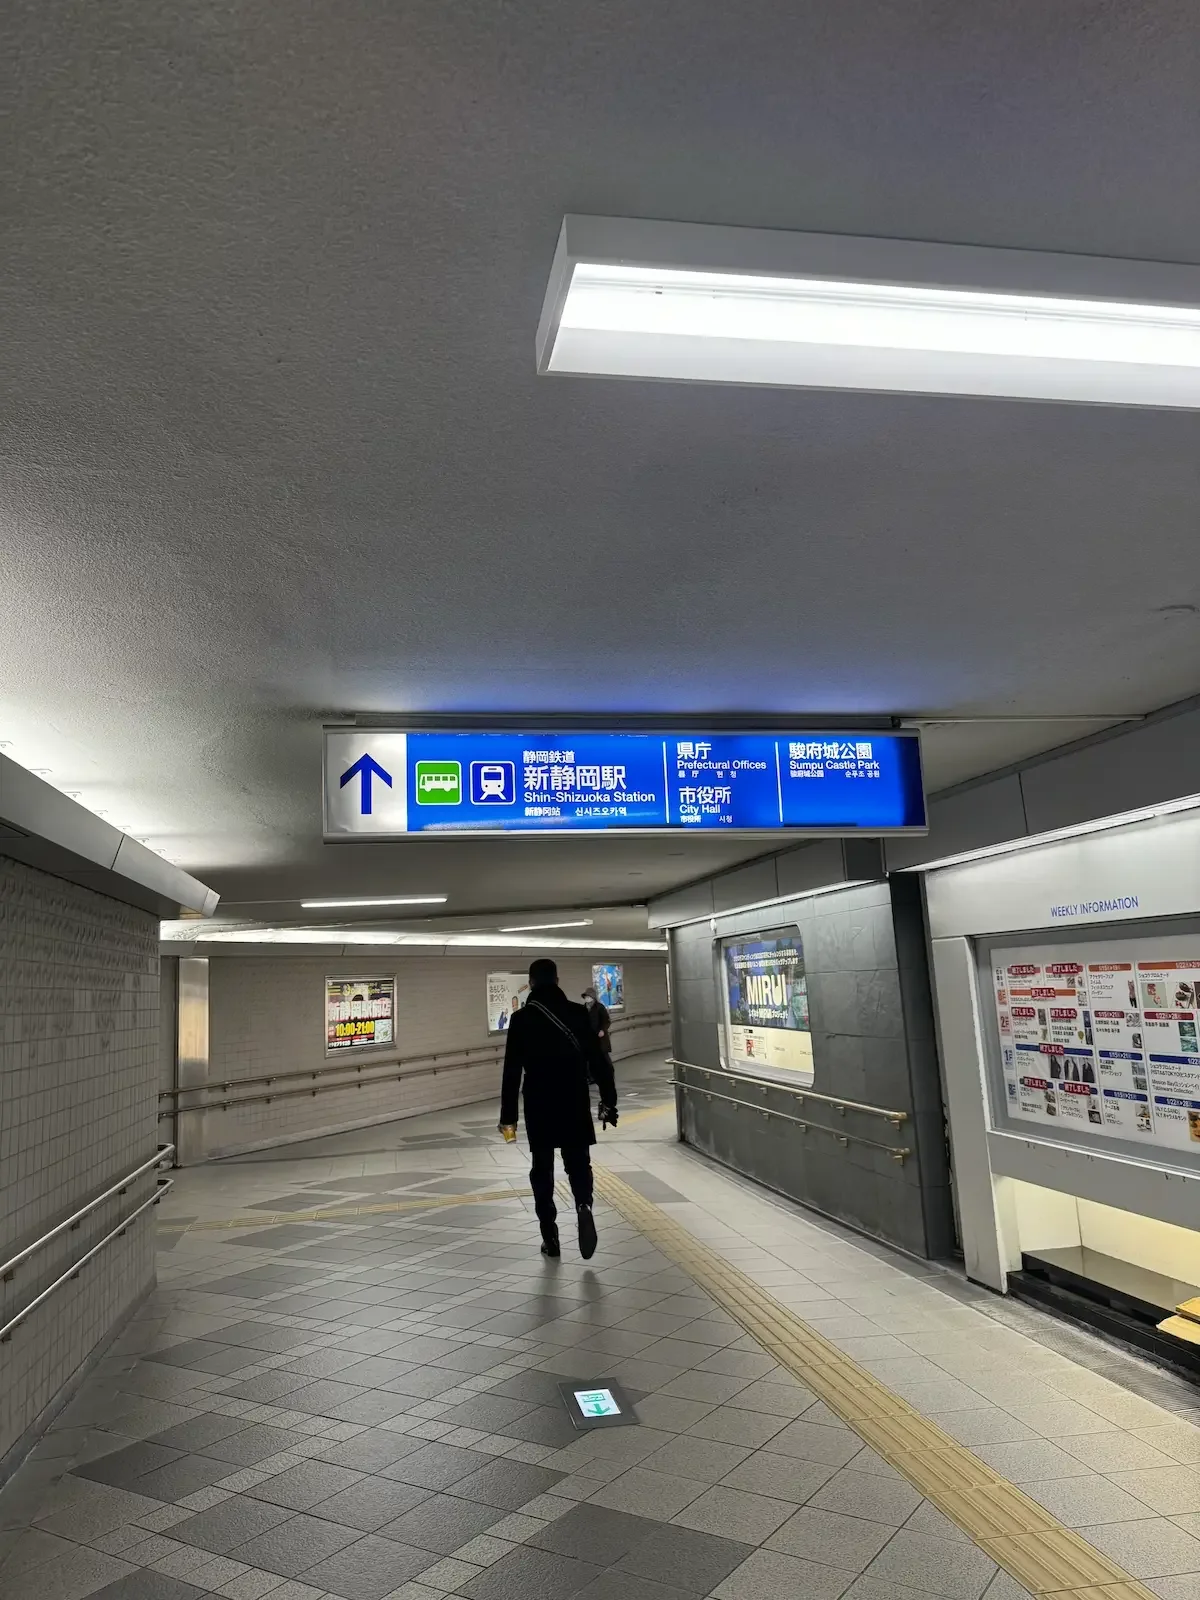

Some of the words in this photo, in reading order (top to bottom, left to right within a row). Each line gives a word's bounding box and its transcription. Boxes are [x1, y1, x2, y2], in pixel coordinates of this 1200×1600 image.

[523, 751, 575, 764] 静岡鉄道
[677, 742, 712, 760] 県庁
[789, 742, 873, 760] 駿府城公園
[677, 760, 730, 770] Prefectural
[732, 760, 767, 770] Offices
[790, 760, 823, 773] Sumpu
[826, 760, 855, 770] Castle
[858, 760, 880, 770] Park
[523, 765, 627, 791] 新静岡駅
[524, 791, 611, 803] Shin-Shizuoka
[613, 791, 655, 802] Station
[679, 786, 731, 804] 市役所
[575, 806, 627, 817] 신시즈오카역
[679, 804, 700, 816] City
[702, 804, 721, 814] Hall
[1050, 904, 1079, 918] WEEKLY
[1080, 896, 1139, 915] INFORMATION
